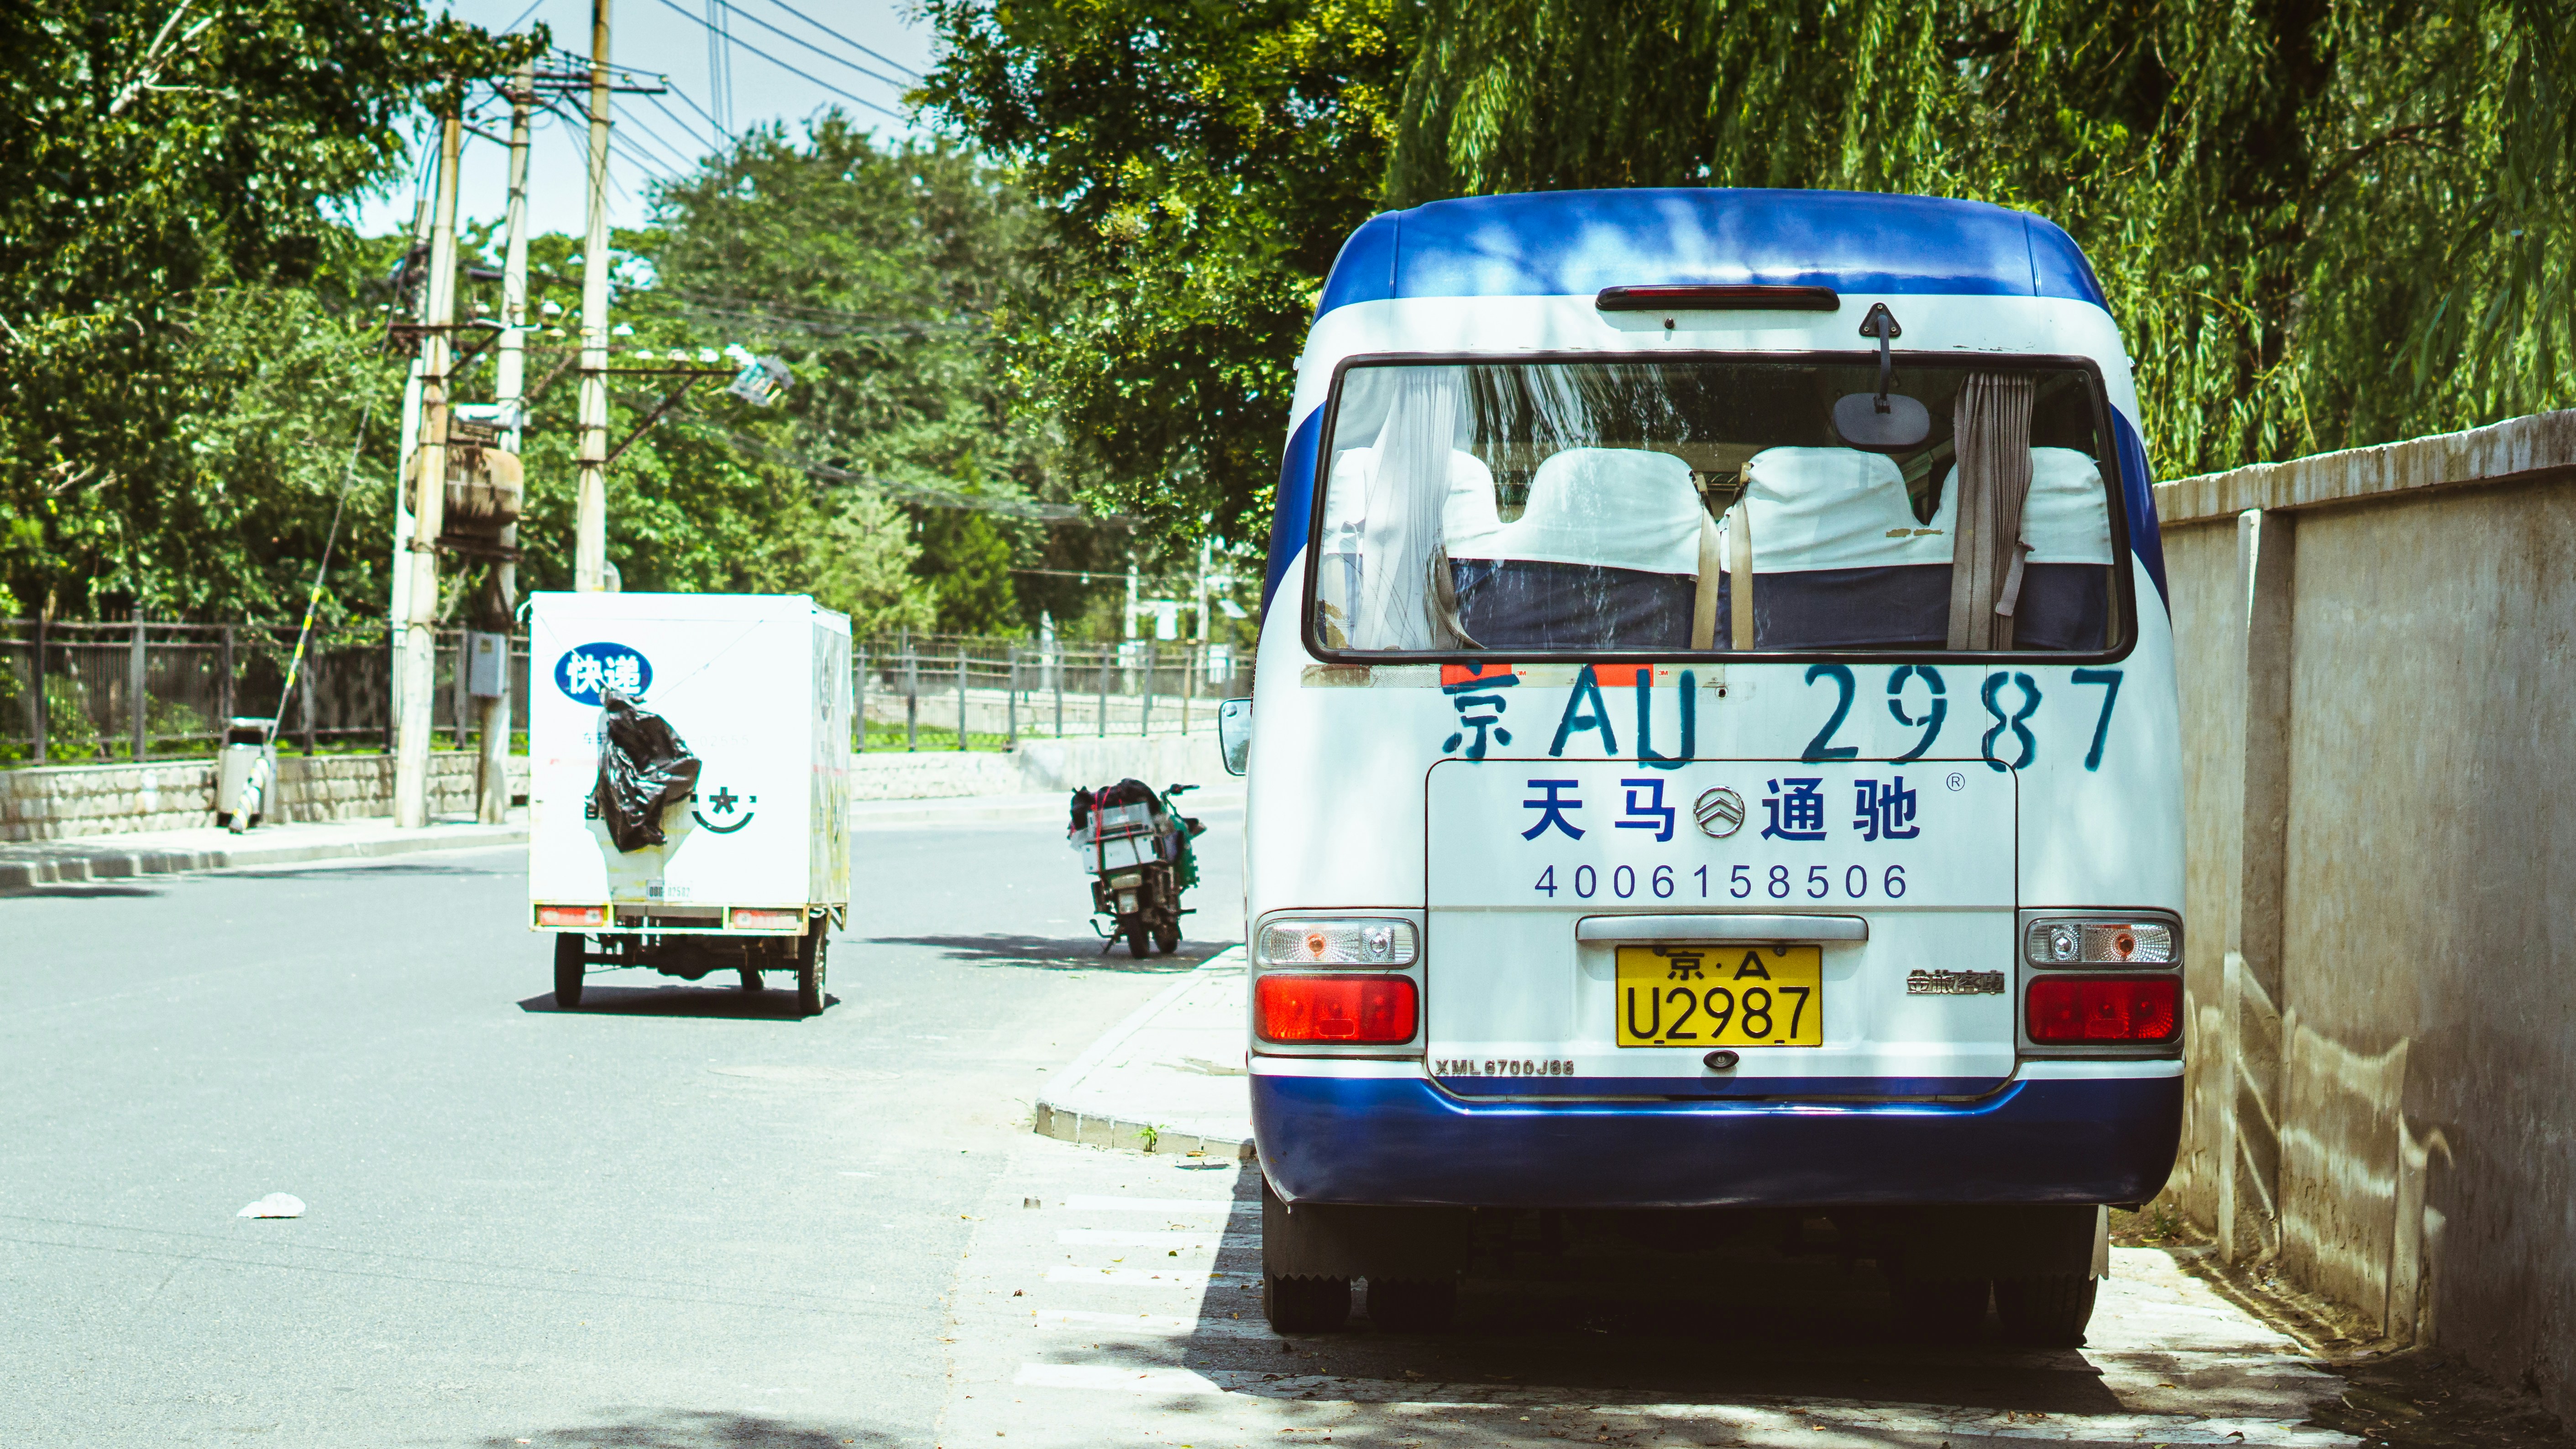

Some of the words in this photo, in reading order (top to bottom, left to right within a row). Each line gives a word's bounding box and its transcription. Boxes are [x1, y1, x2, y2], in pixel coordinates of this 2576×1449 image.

[566, 654, 643, 695] 快递
[1802, 664, 2123, 773] 2987
[1534, 864, 1907, 898] 4006158506
[1628, 987, 1810, 1039] U2987
[1435, 1058, 1575, 1076] XML6700J88
